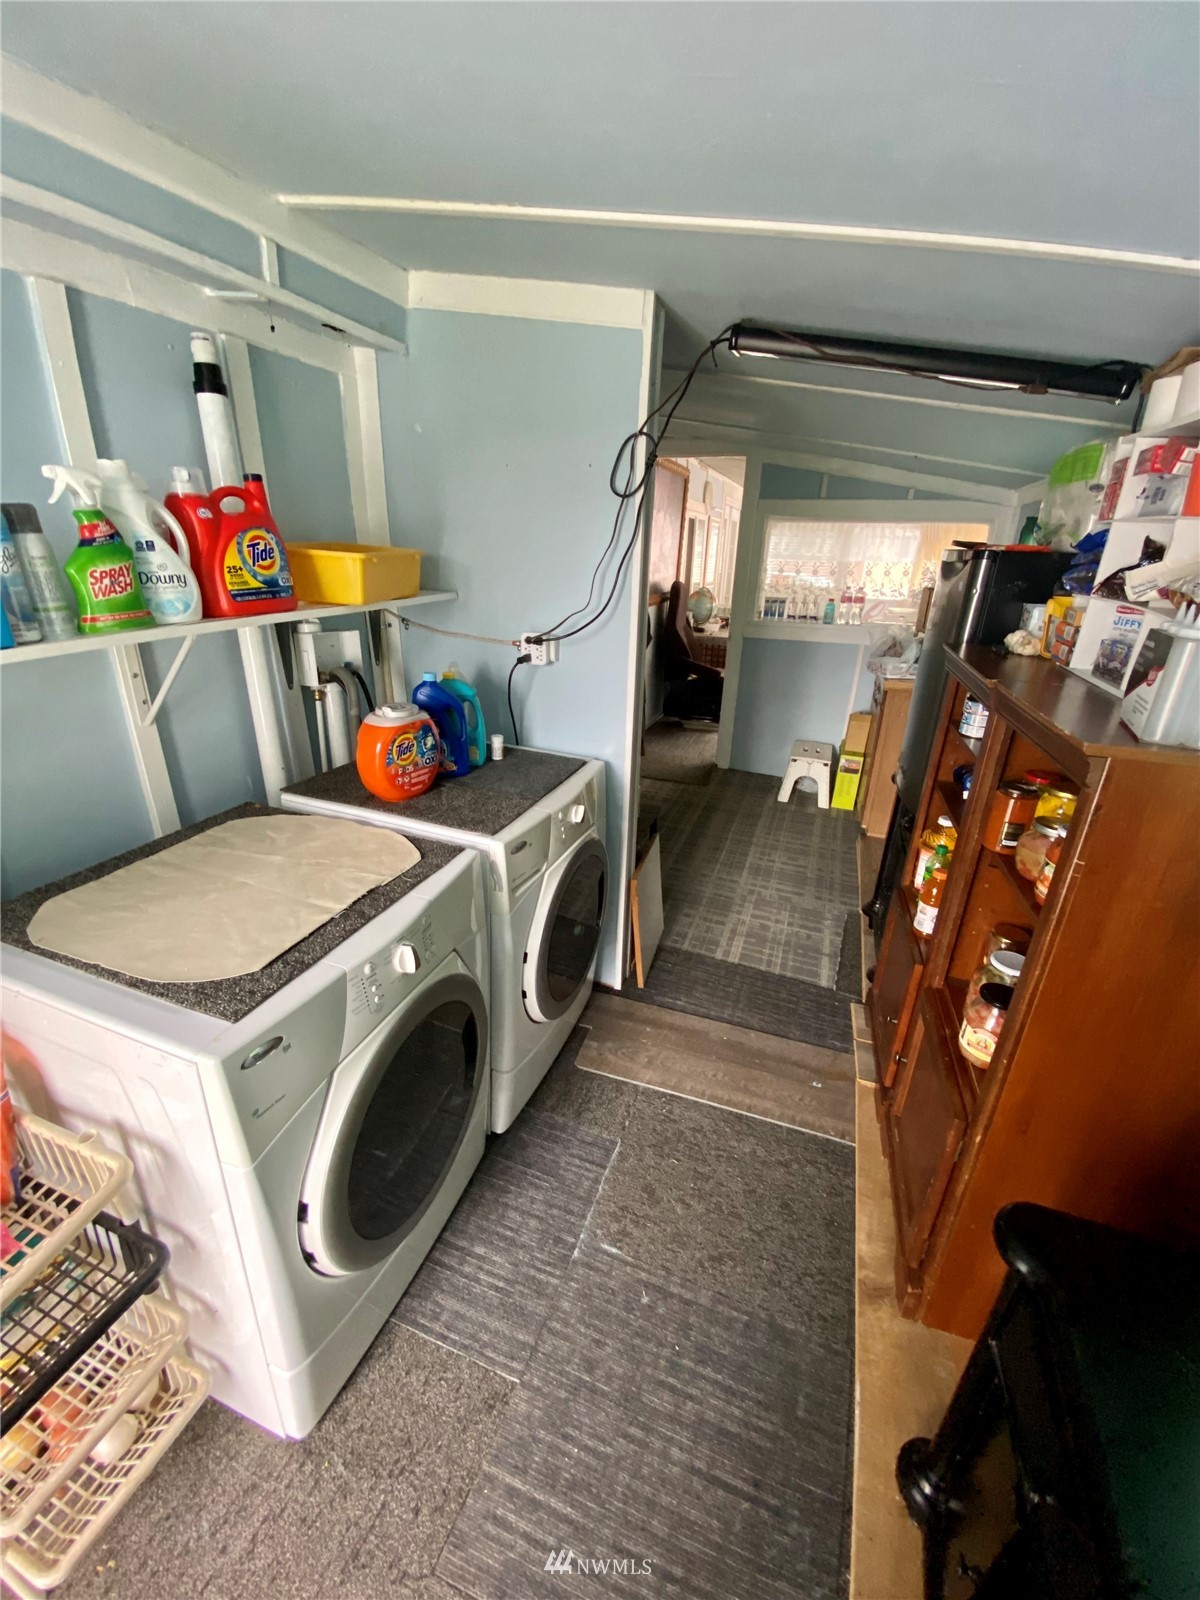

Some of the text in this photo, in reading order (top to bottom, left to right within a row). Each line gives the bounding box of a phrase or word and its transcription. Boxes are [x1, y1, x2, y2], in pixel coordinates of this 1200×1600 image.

[246, 541, 275, 568] Tide
[89, 563, 132, 586] SPRAY
[138, 571, 187, 588] Downy
[226, 565, 243, 574] 25+
[92, 577, 133, 599] WASH
[1113, 615, 1142, 629] JIFFY
[396, 741, 415, 762] Tide
